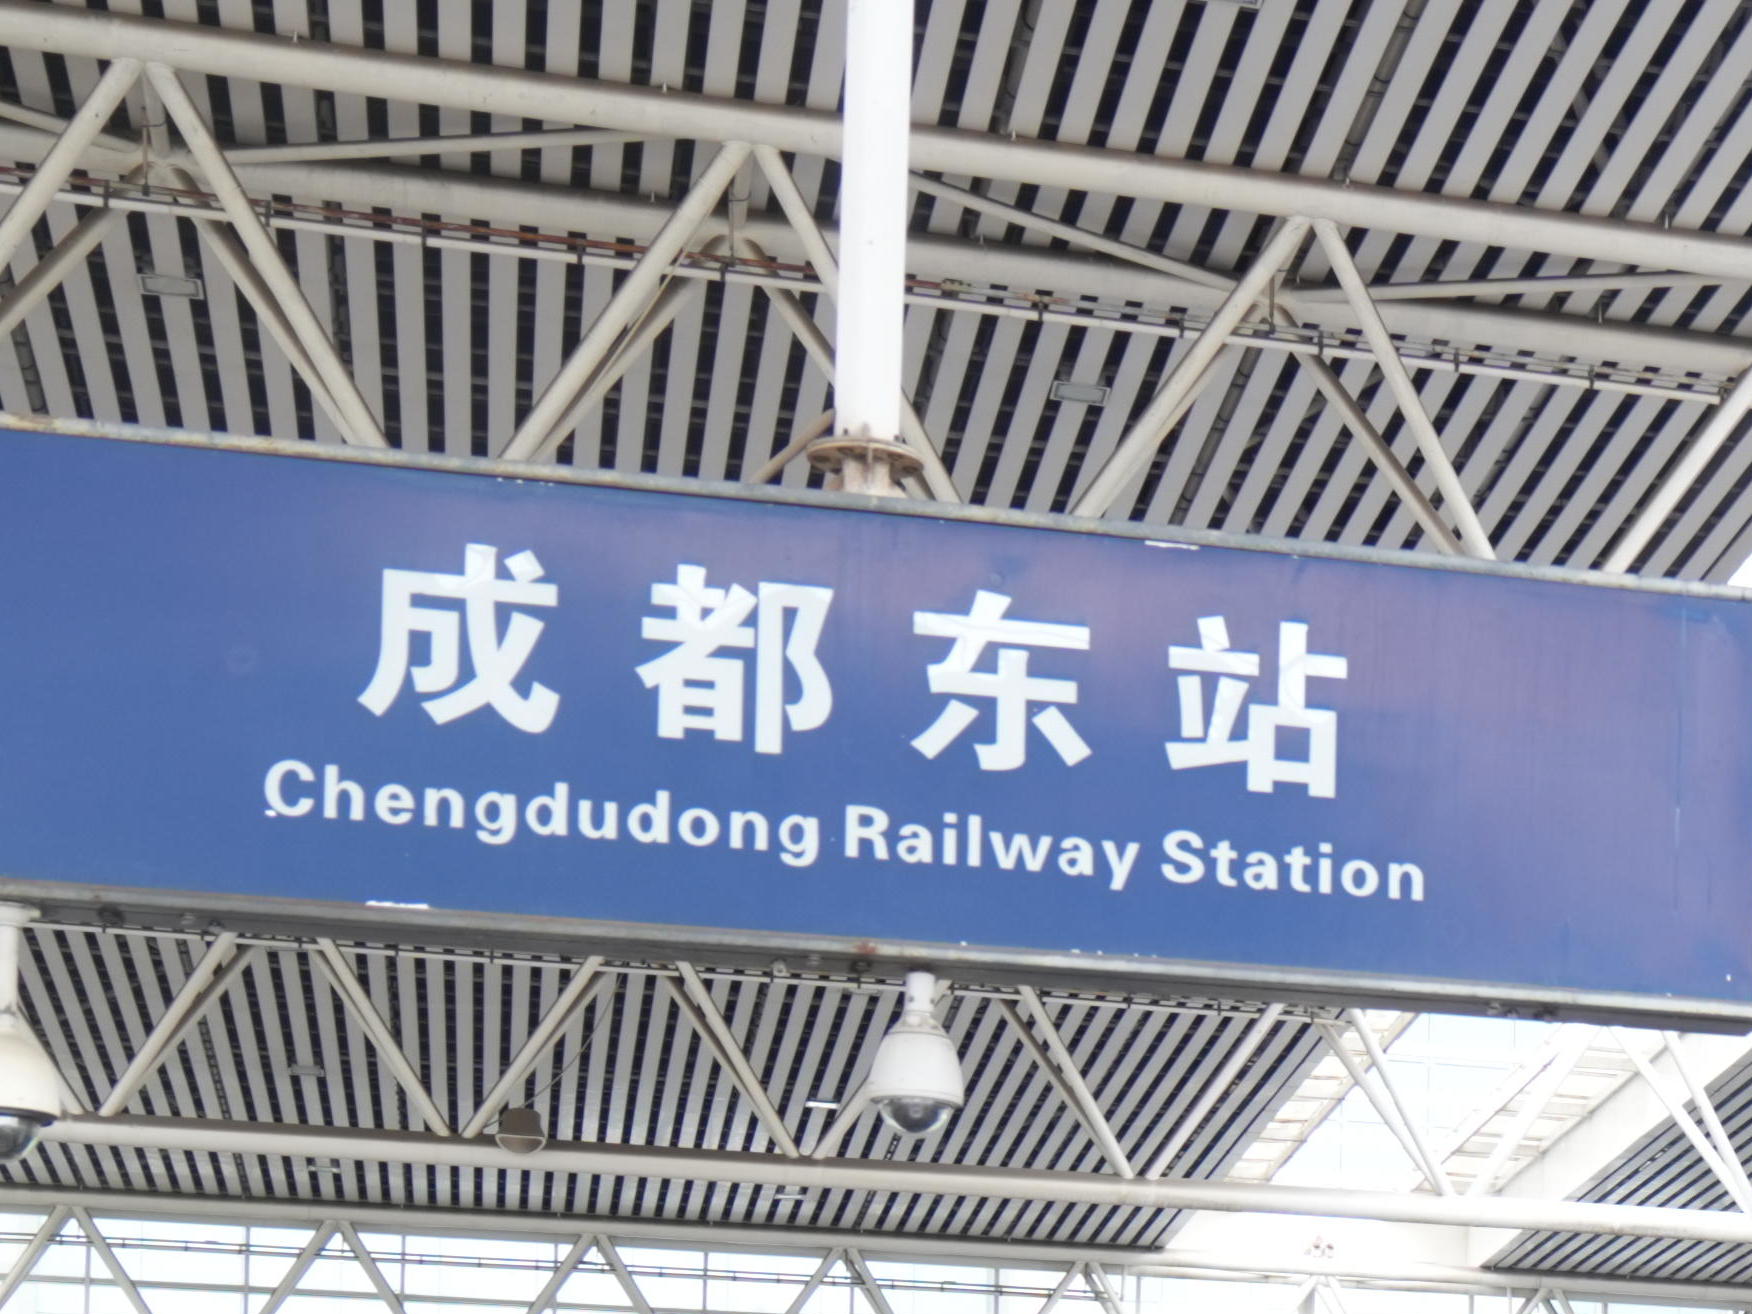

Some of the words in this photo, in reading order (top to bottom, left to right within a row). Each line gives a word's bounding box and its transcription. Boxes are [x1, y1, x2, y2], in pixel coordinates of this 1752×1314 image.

[357, 542, 1349, 799] 成都东站
[264, 759, 820, 868] Chengdudong
[844, 804, 1140, 891] Railway
[1161, 829, 1426, 902] Station
